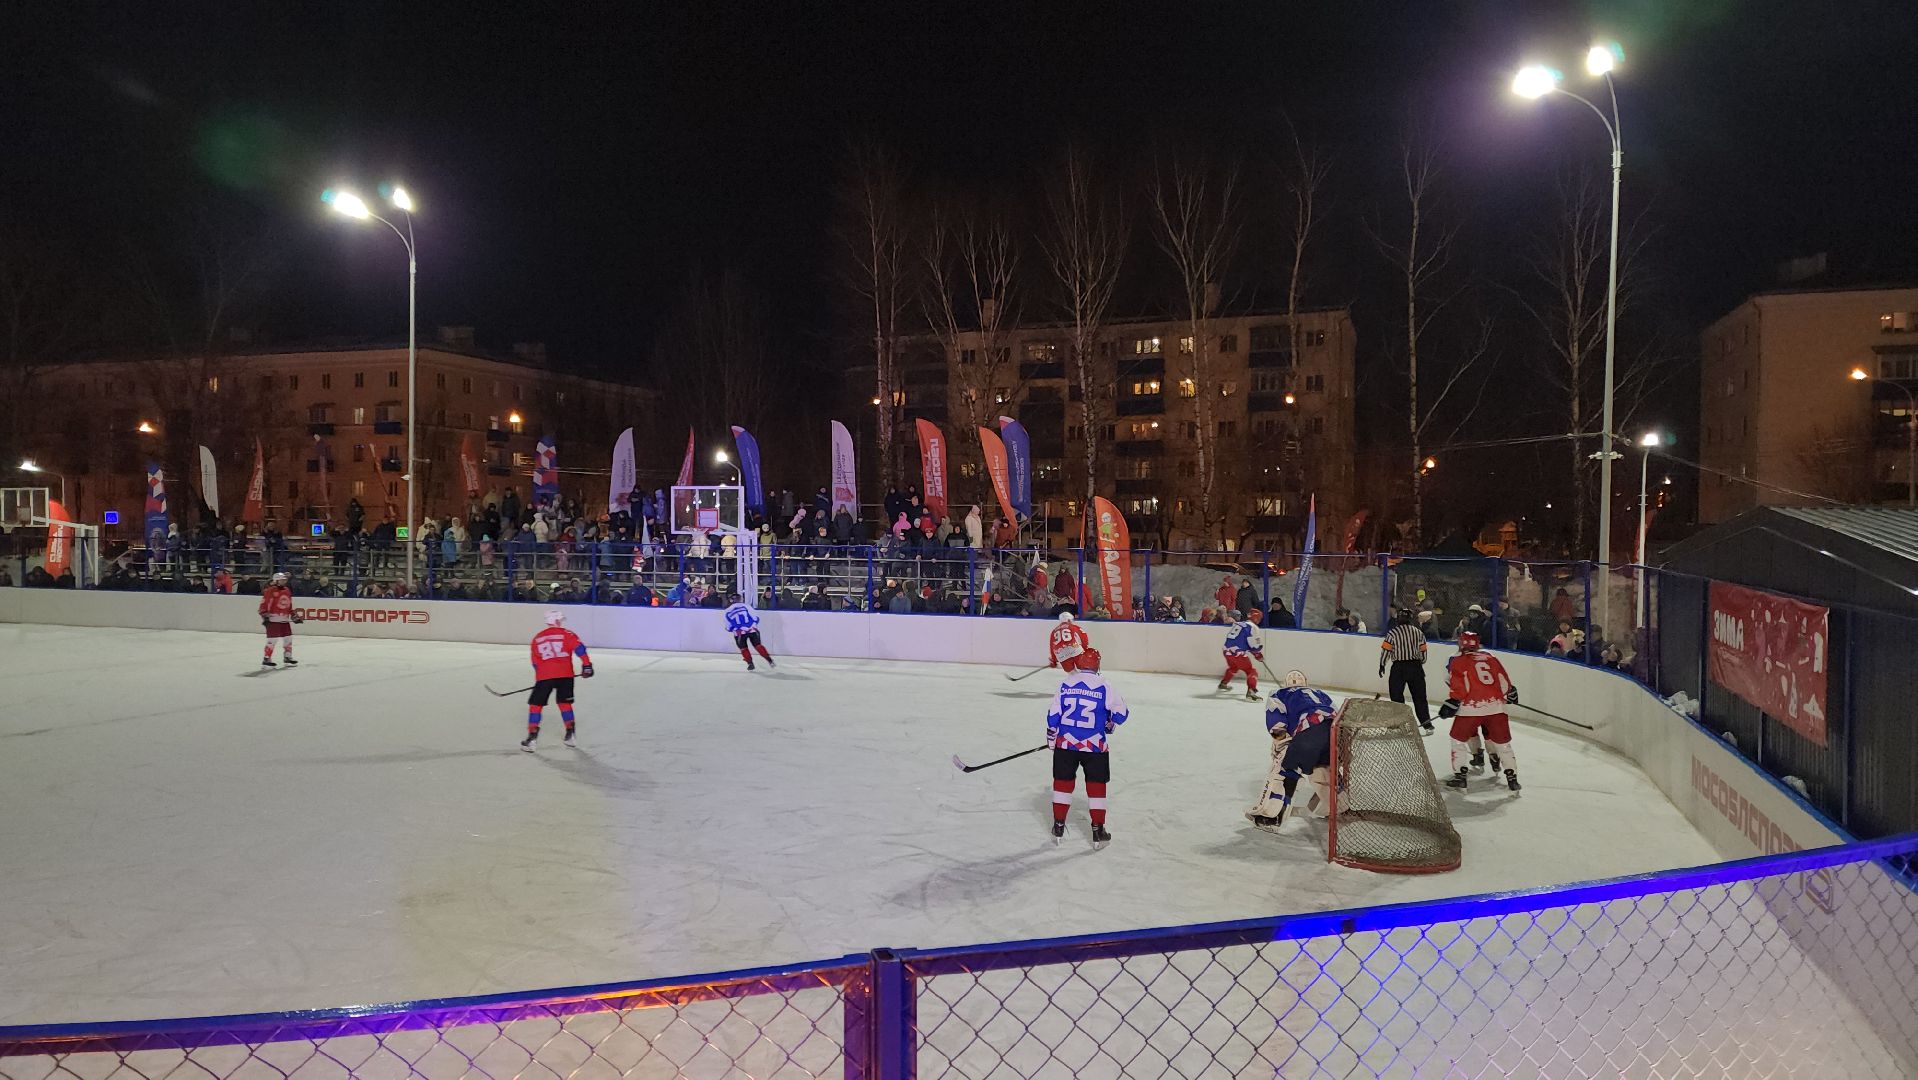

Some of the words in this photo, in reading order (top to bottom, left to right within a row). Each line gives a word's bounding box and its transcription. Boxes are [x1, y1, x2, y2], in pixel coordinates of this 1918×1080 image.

[295, 607, 412, 624] ОСОБЛСПОРТ
[730, 610, 750, 625] 77
[1053, 628, 1073, 646] 96
[1713, 609, 1744, 651] ЗИМА
[1474, 661, 1495, 685] 6
[1060, 697, 1098, 729] 23
